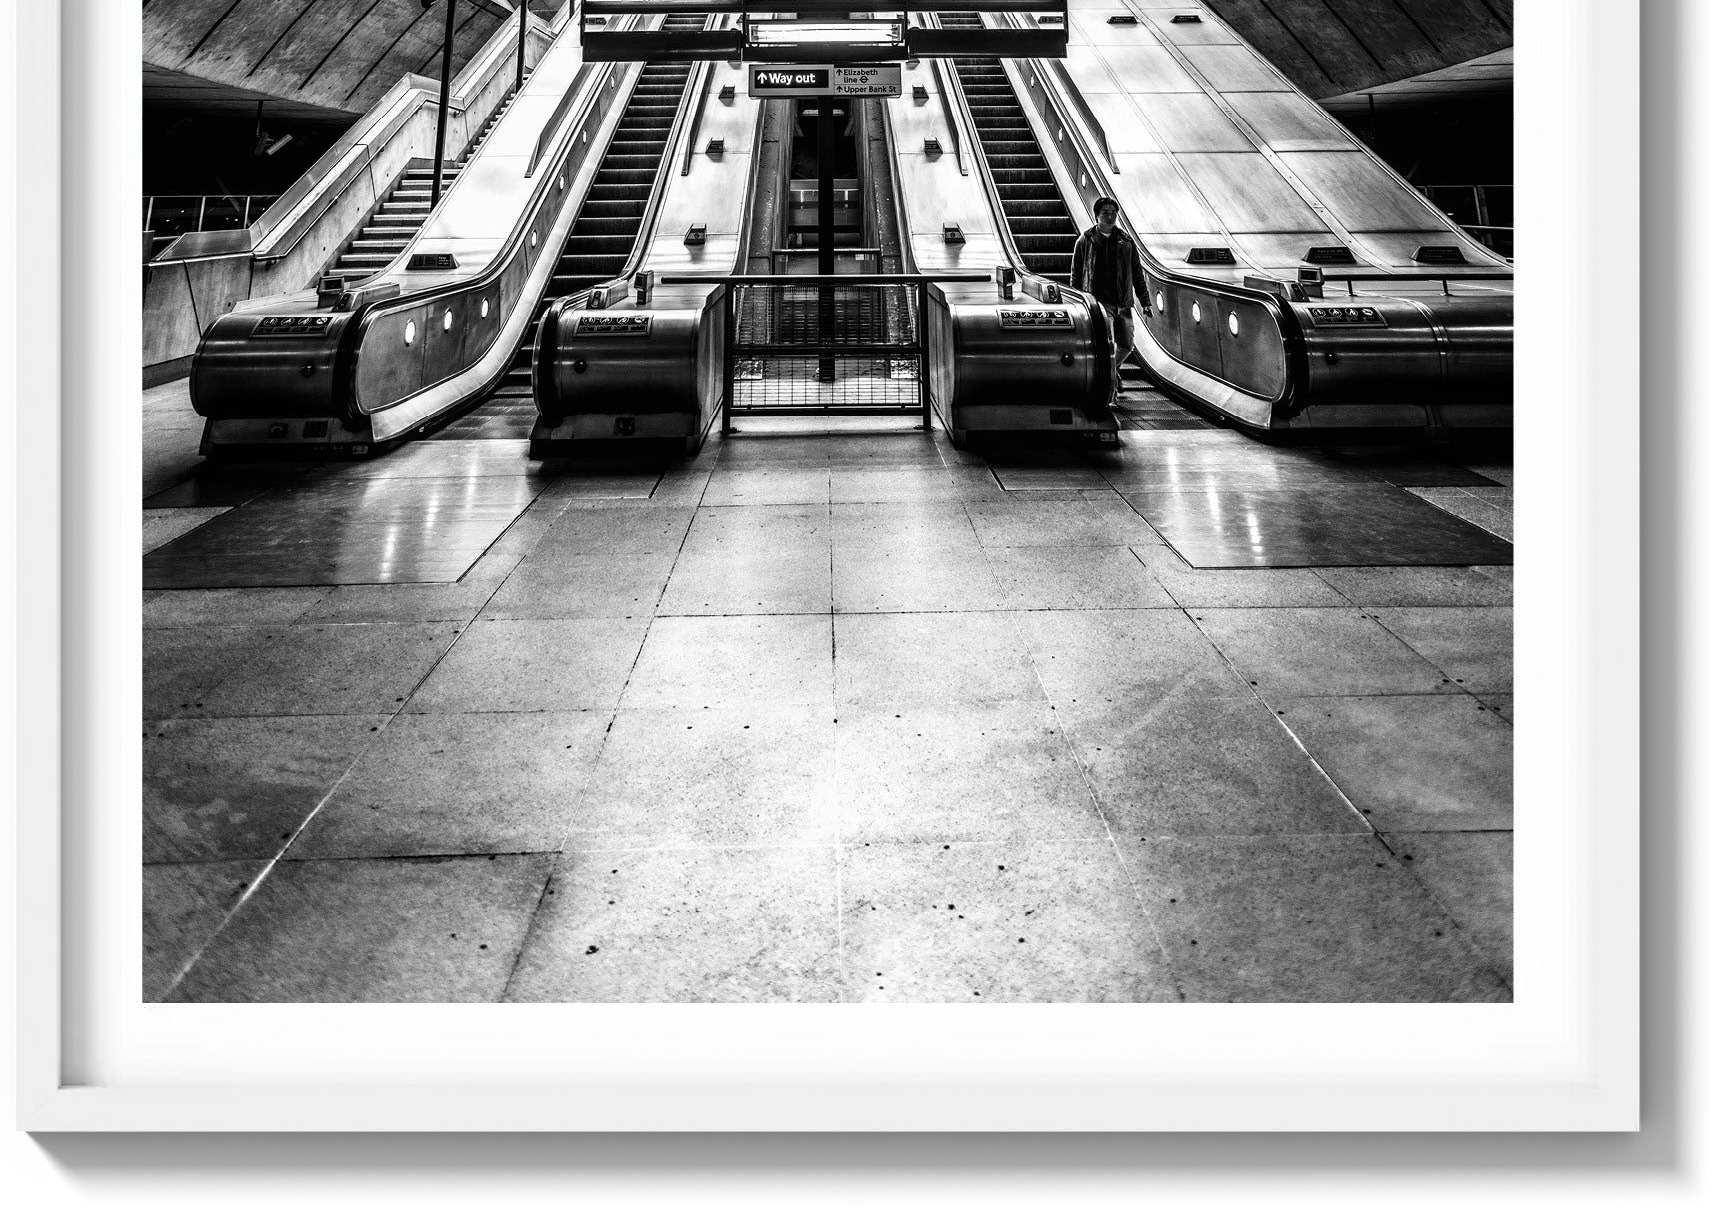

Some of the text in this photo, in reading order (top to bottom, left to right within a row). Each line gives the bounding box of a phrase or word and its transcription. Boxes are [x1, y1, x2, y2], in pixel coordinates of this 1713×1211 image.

[769, 73, 816, 85] Way out
[843, 86, 867, 94] Upper
